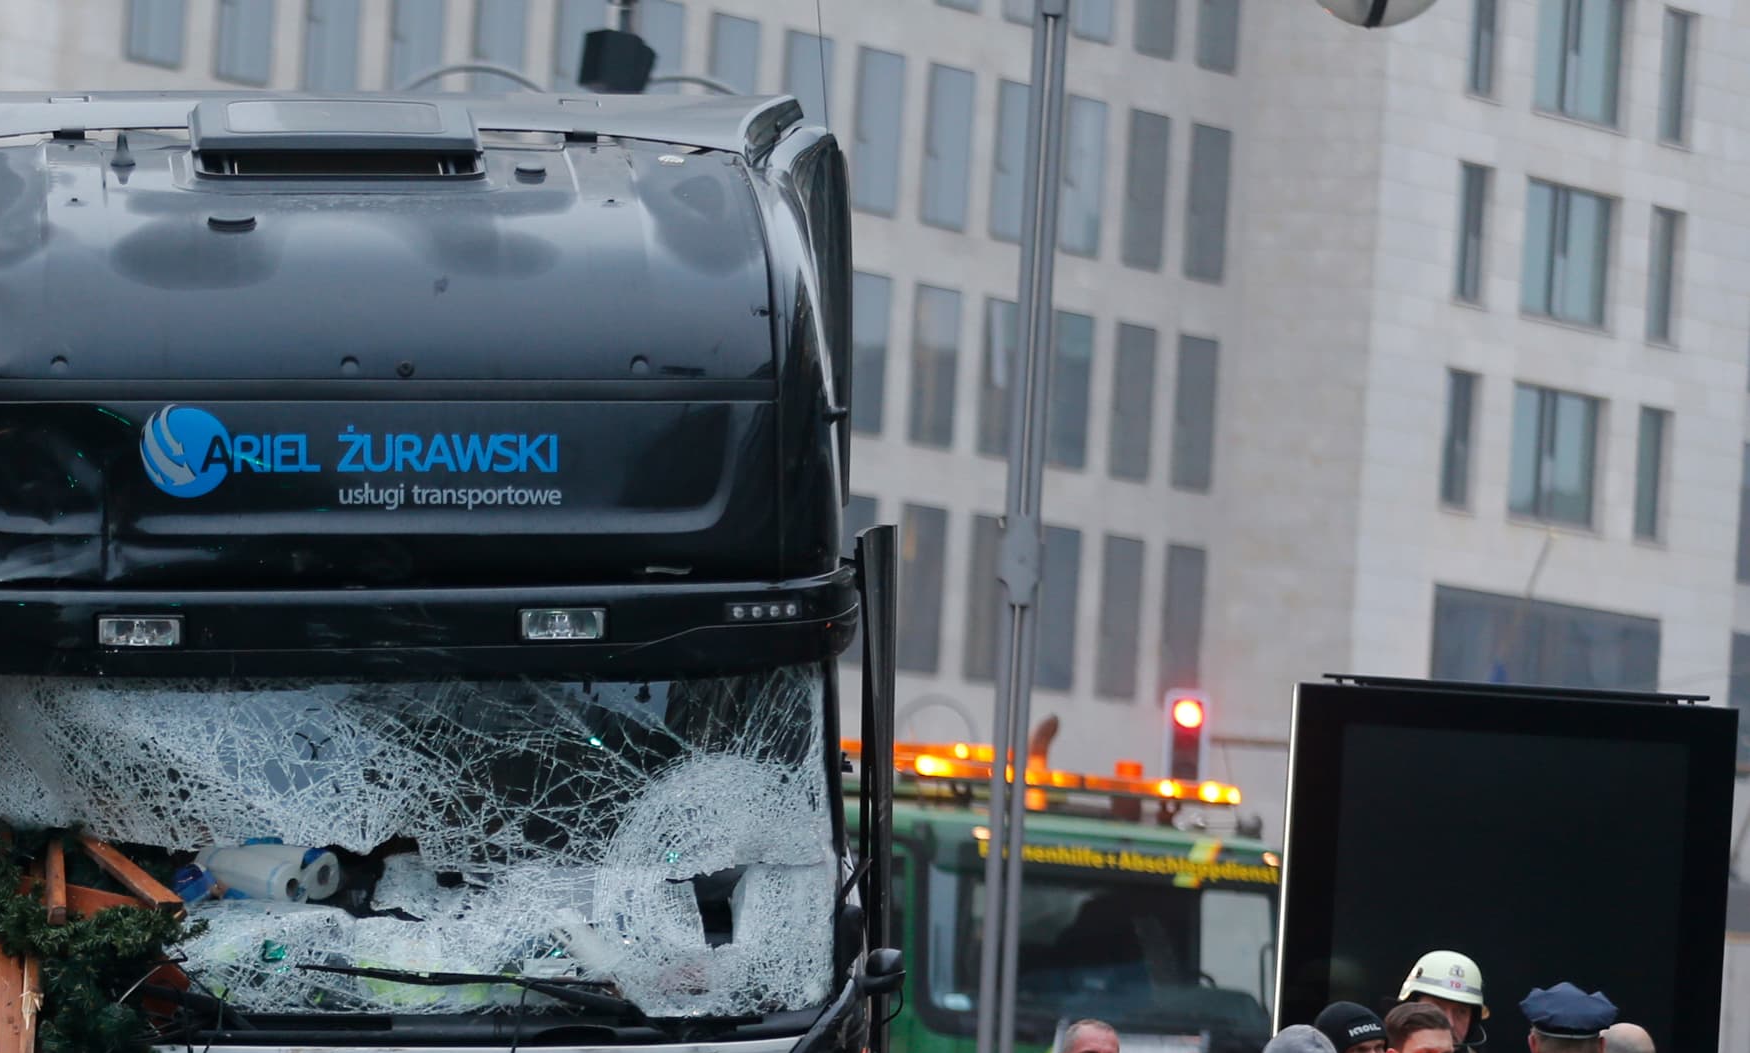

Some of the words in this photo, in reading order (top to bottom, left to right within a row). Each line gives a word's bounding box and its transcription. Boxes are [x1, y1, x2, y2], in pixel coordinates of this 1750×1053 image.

[201, 433, 320, 474] ARIEL
[337, 425, 558, 474] ŻURAWSKI
[339, 483, 405, 511] usługi
[412, 484, 562, 510] transportowe
[1348, 1023, 1382, 1038] KROLL
